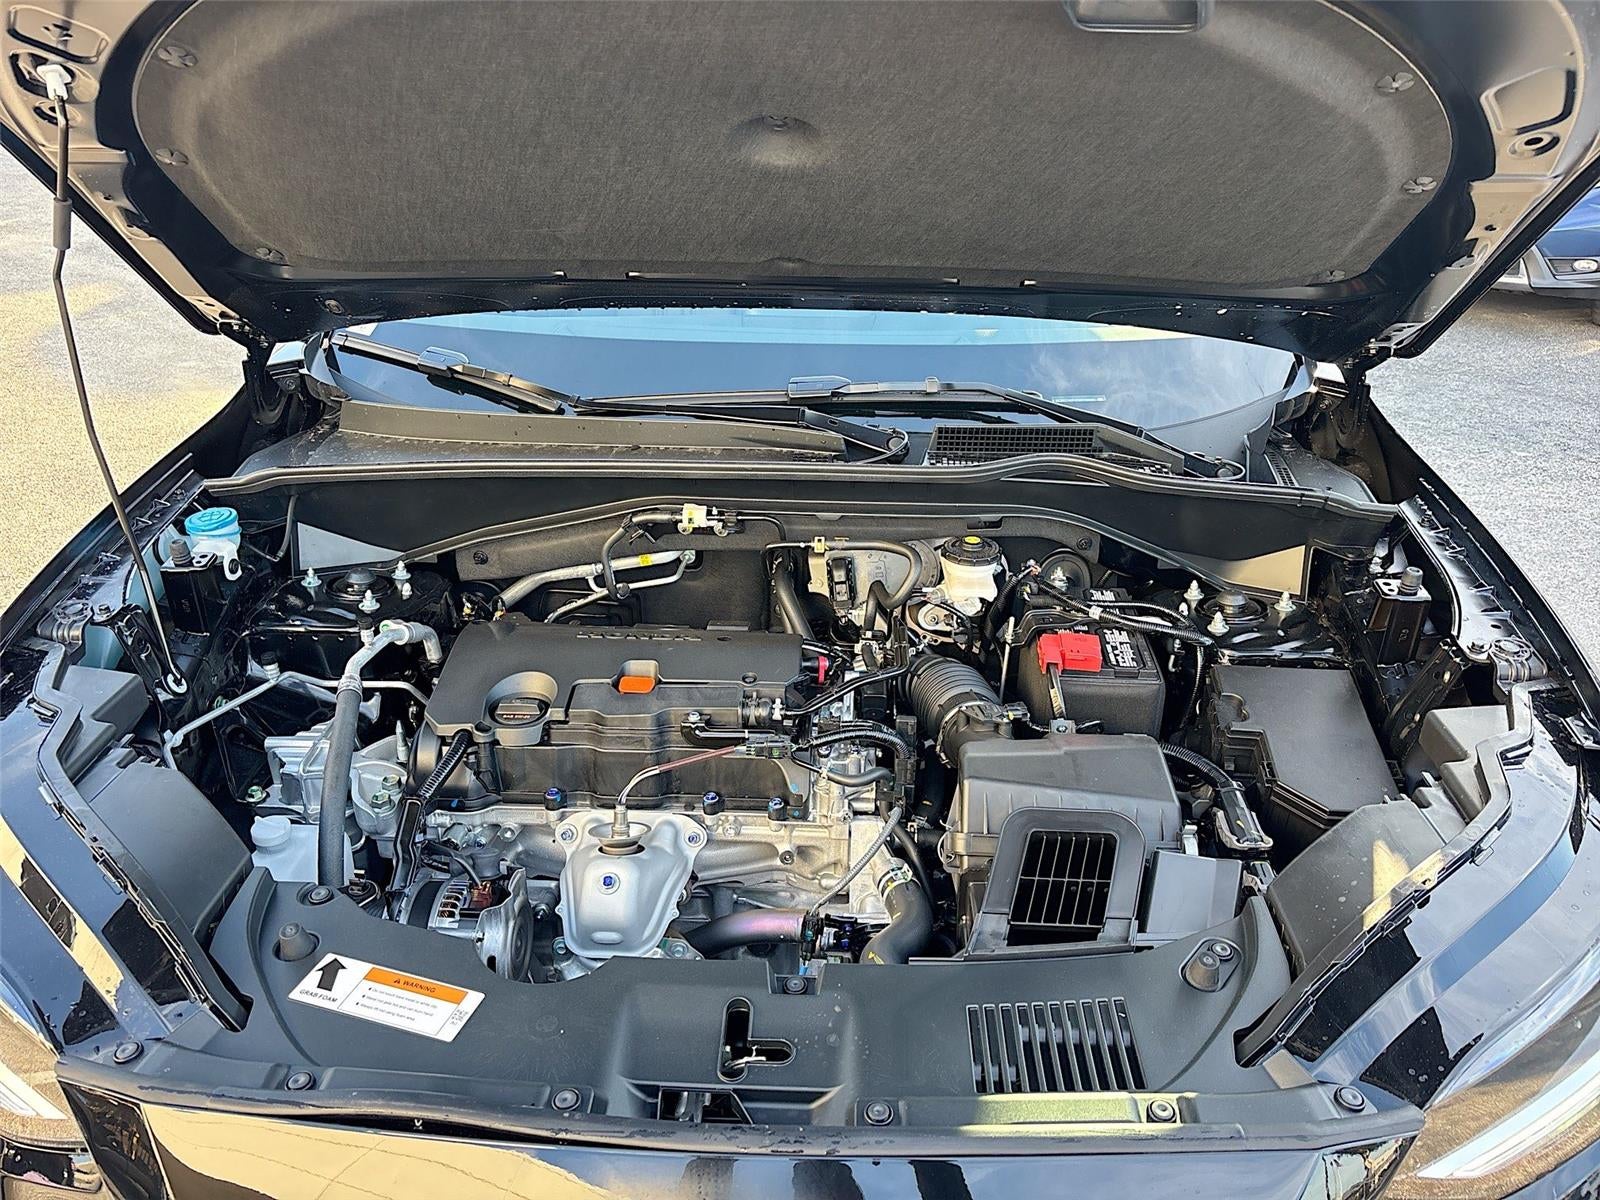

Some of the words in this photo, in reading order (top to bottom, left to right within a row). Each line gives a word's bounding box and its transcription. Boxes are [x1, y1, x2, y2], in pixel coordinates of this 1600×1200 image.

[403, 980, 437, 994] WARNING
[299, 988, 318, 998] GRAB
[318, 993, 339, 1003] FOAM
